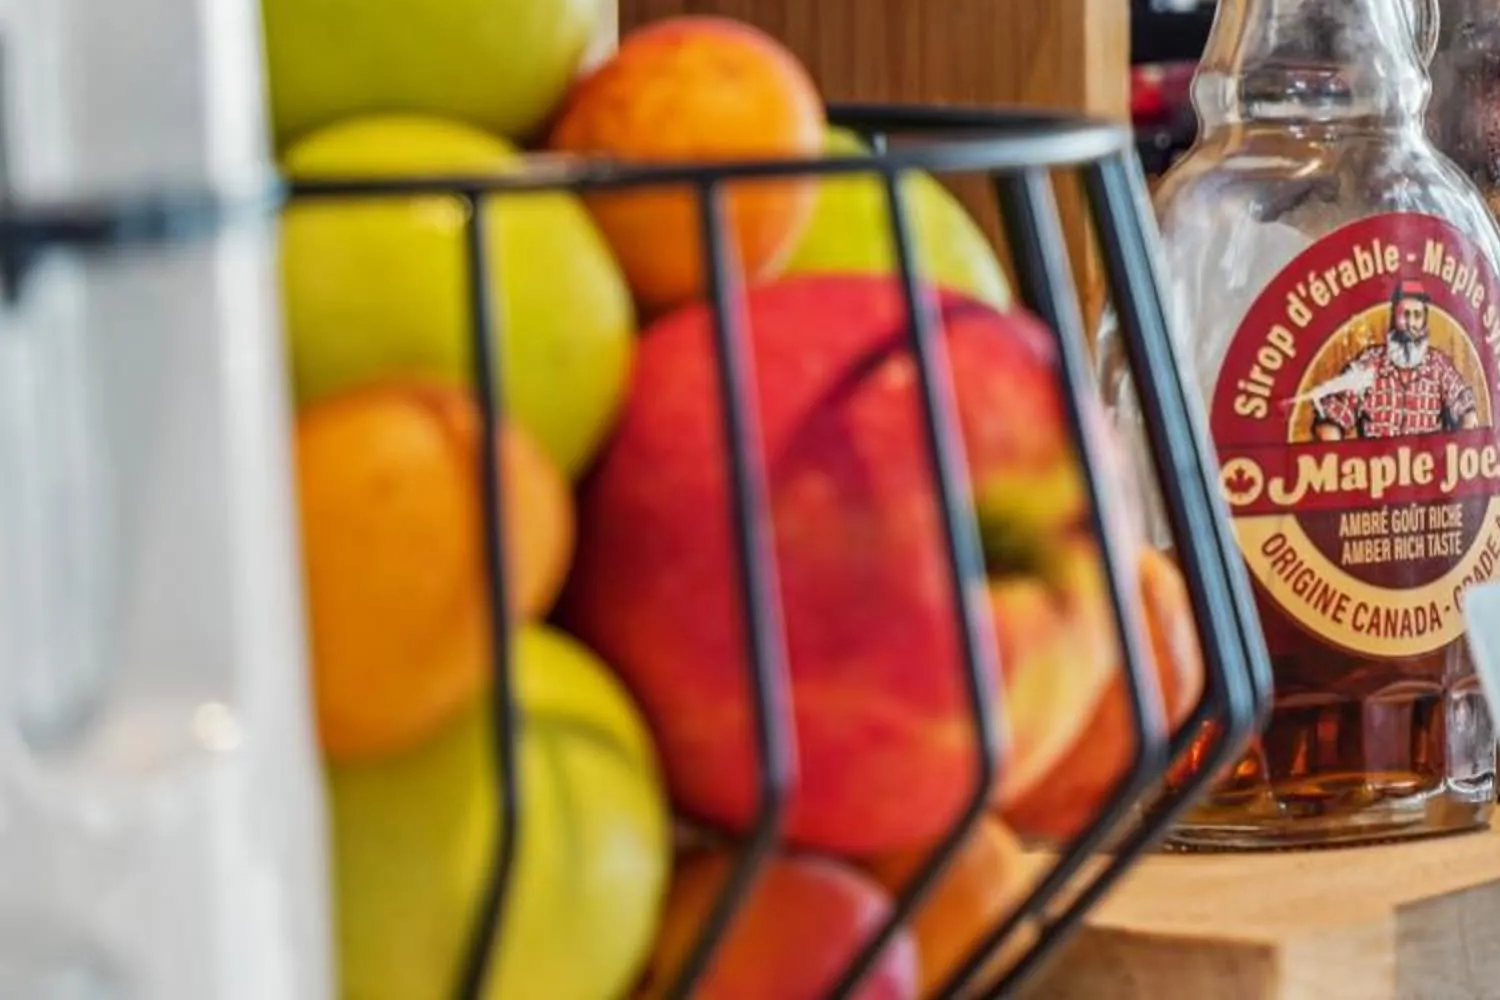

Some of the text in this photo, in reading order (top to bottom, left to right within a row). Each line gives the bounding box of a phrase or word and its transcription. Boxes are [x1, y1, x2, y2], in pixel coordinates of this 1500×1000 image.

[1234, 324, 1297, 419] Sirop
[1286, 238, 1400, 328] d'érable
[1422, 239, 1486, 310] Maple
[1268, 446, 1434, 506] Maple
[1340, 502, 1463, 538] AMBRÉ GOÛT RICHE
[1341, 530, 1462, 565] AMBER RICH TASTE
[1261, 532, 1352, 624] ORIGINE
[1351, 601, 1442, 639] CANADA
